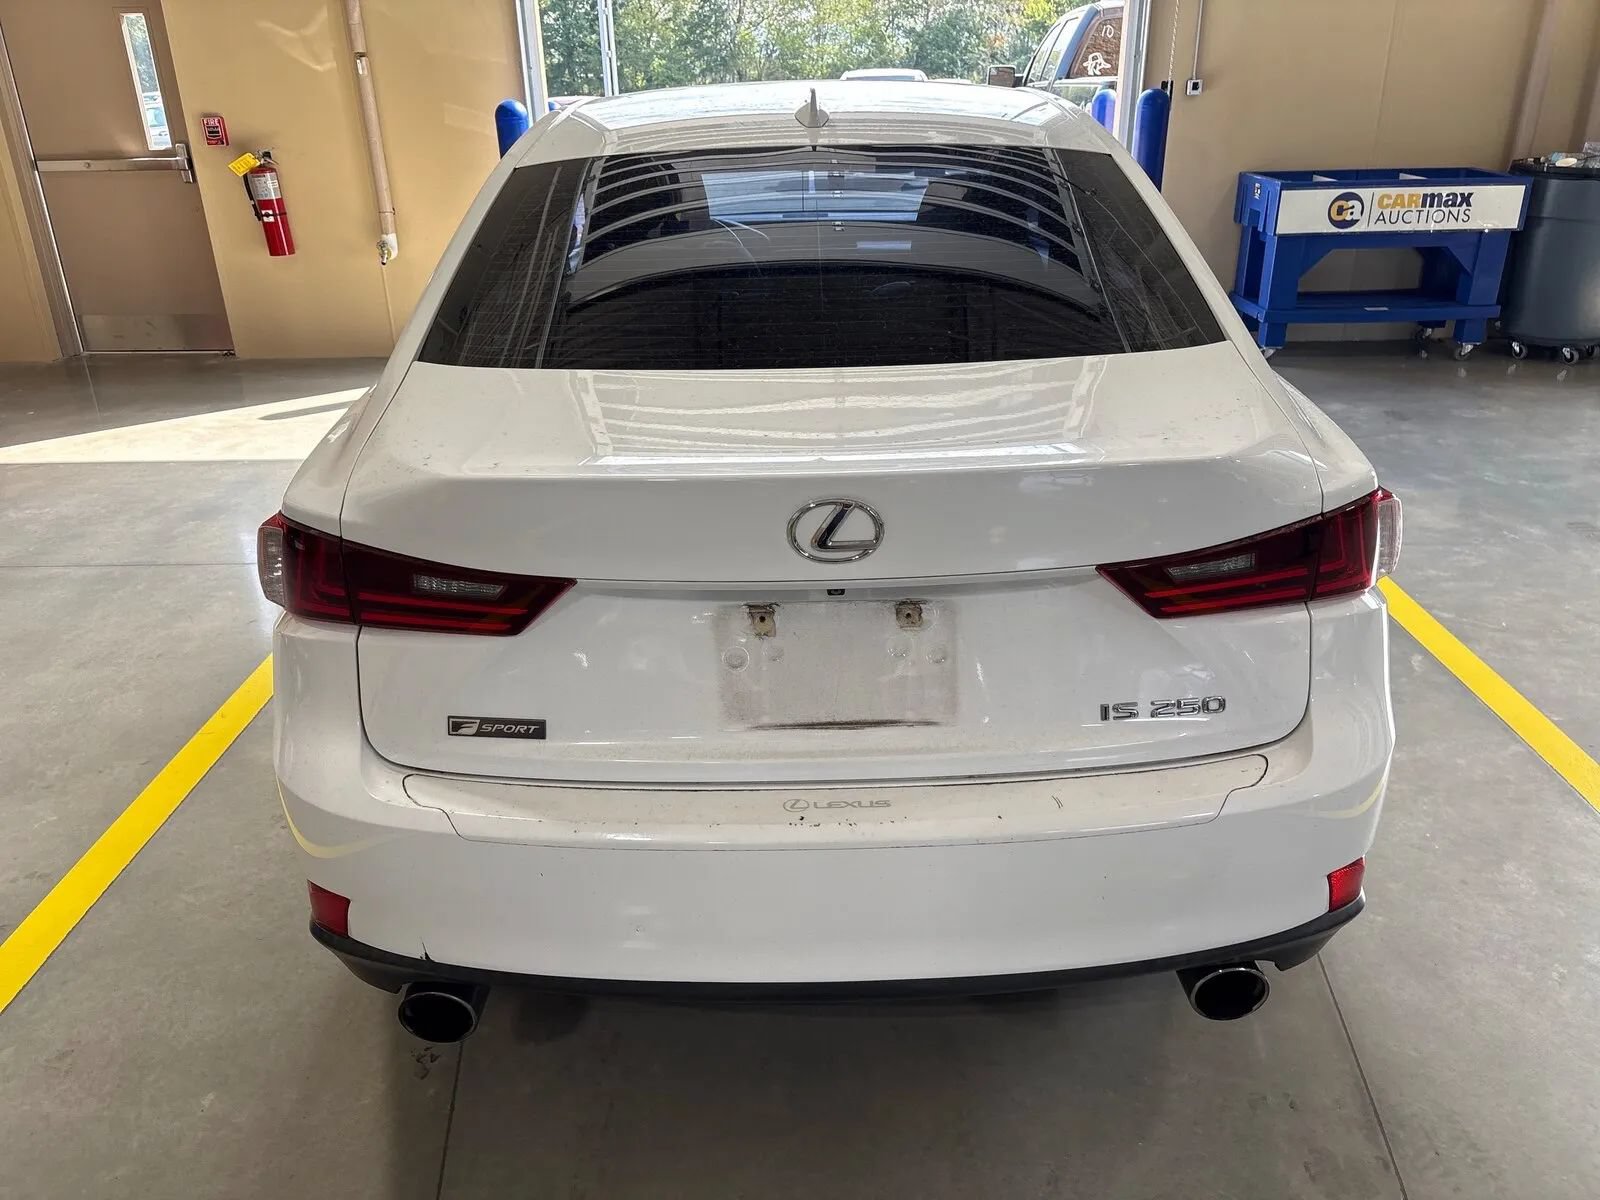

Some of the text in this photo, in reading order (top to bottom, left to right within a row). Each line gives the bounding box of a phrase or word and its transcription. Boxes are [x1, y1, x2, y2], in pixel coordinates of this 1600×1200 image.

[203, 118, 220, 126] FIRE
[1374, 208, 1472, 225] AUCTIONS
[1099, 695, 1226, 721] IS 250
[479, 723, 540, 734] SPORT
[813, 800, 892, 809] LEXUS
